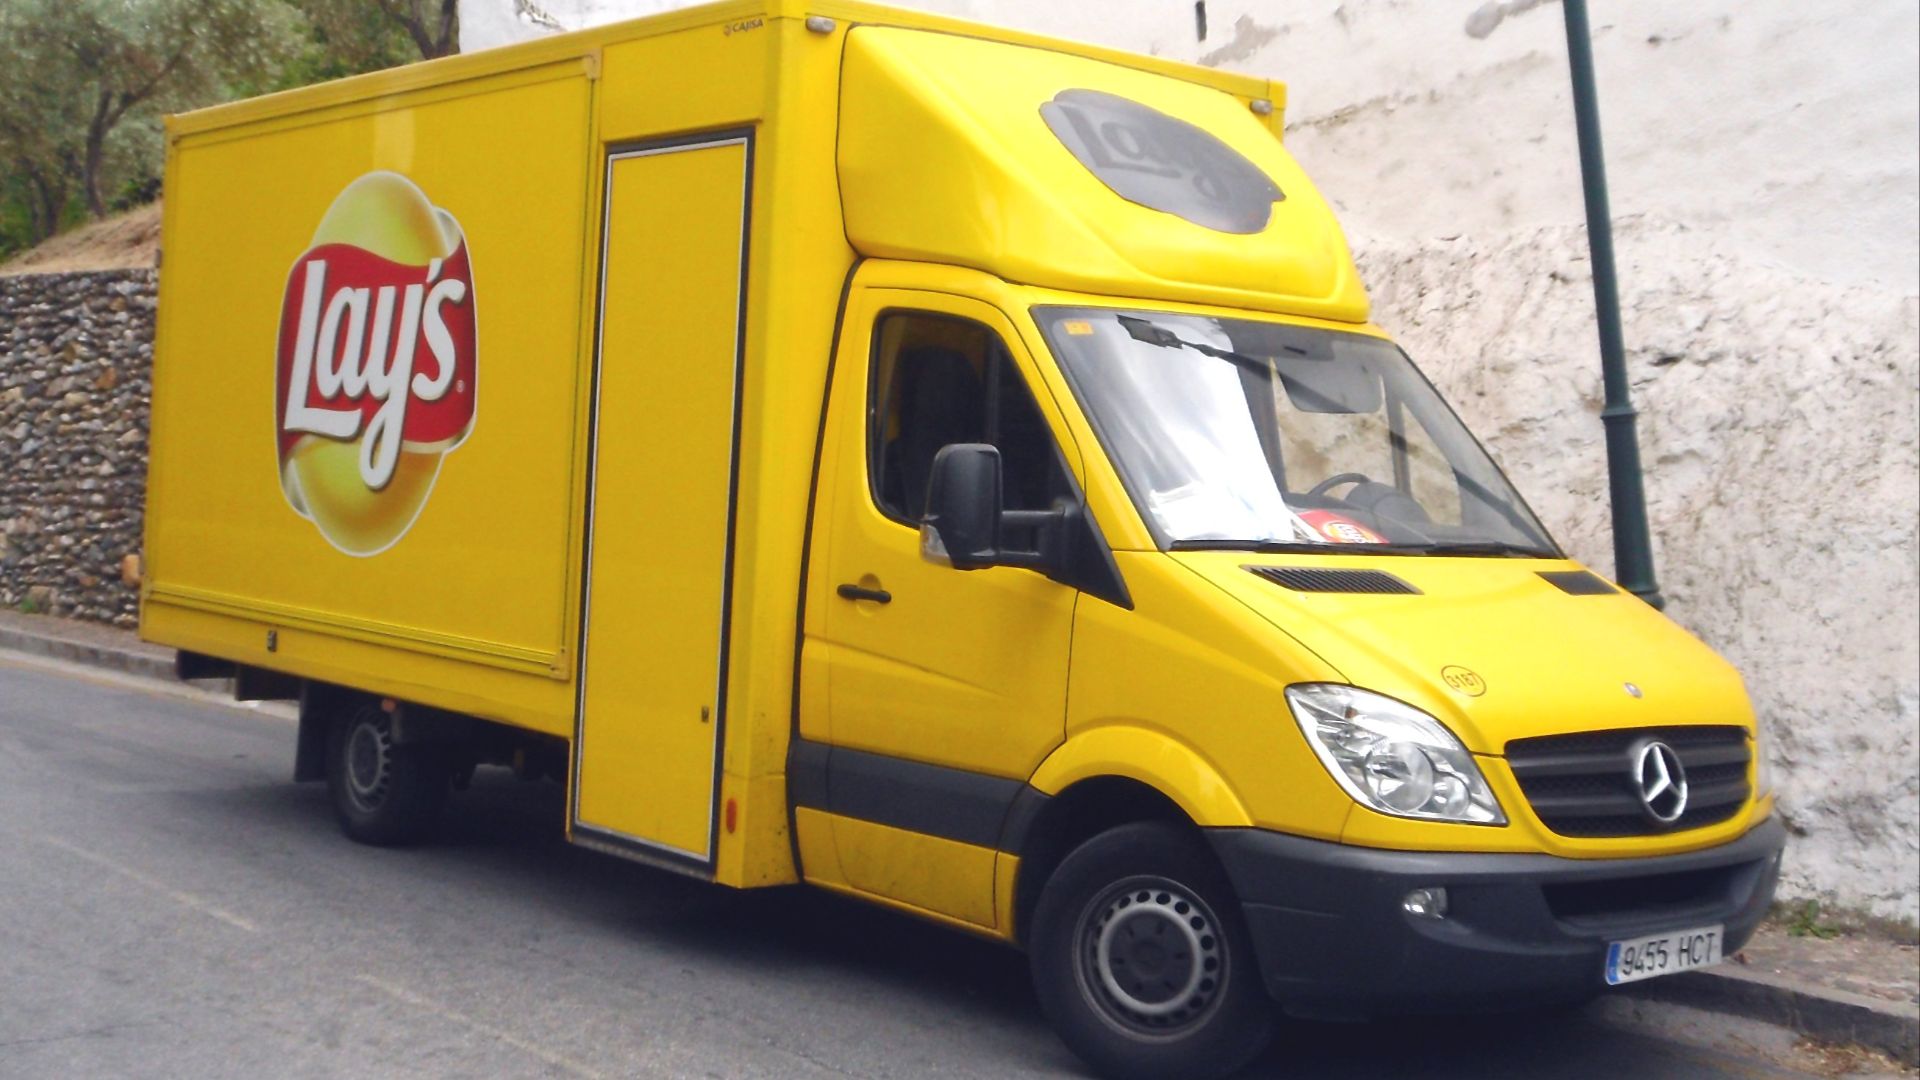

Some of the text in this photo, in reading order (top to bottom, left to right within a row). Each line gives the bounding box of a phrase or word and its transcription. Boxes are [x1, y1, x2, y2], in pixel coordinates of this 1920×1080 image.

[284, 257, 466, 490] Lay's
[1446, 673, 1480, 688] 3187
[1622, 932, 1716, 976] 9455 HCT
